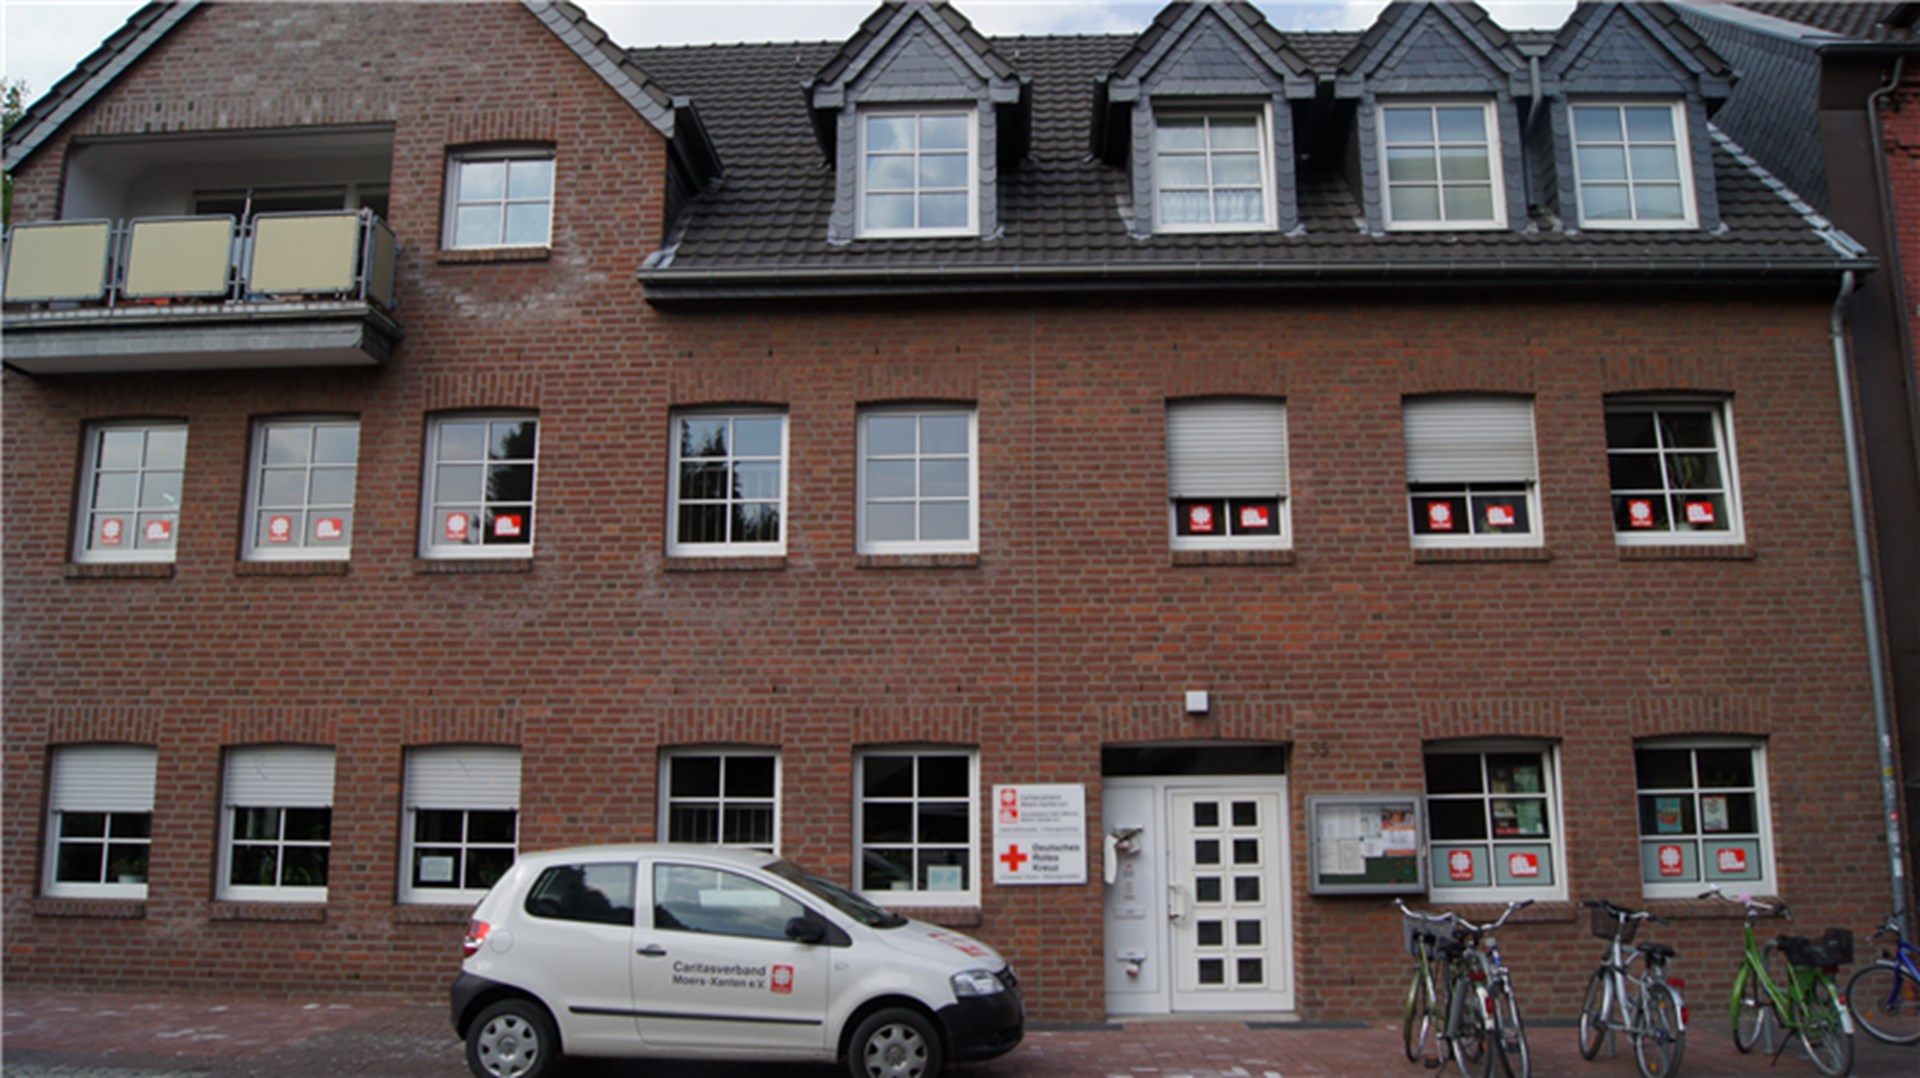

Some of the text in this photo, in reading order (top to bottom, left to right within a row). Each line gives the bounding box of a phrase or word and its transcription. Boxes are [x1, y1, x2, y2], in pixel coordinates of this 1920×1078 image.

[1032, 843, 1080, 851] Deutsches
[1032, 853, 1060, 862] Rotes
[1032, 863, 1060, 872] Kreuz
[673, 961, 767, 976] Caritasverband
